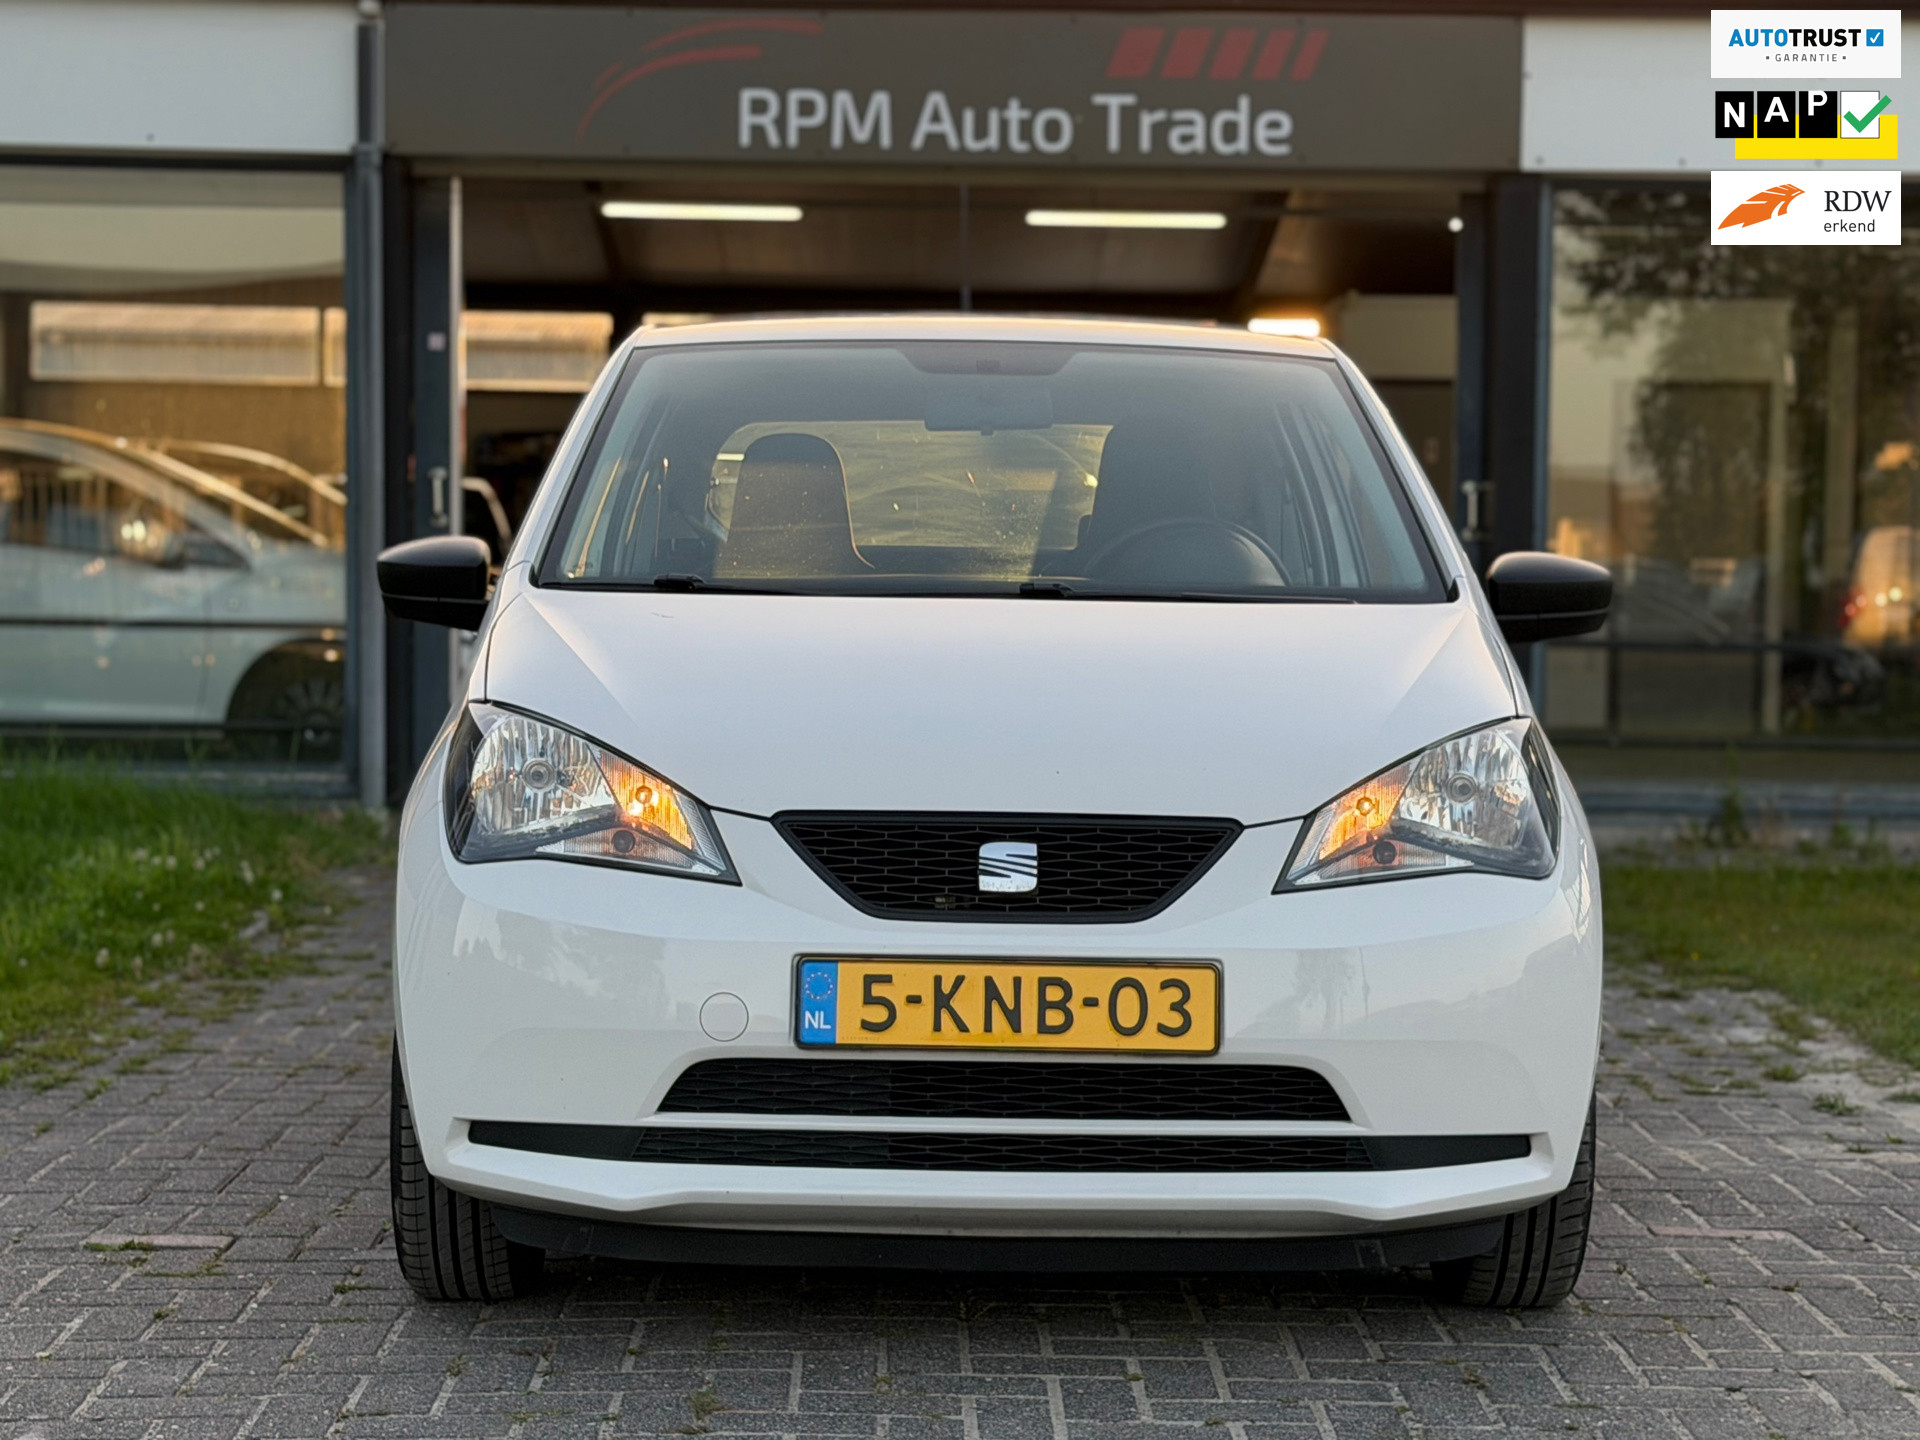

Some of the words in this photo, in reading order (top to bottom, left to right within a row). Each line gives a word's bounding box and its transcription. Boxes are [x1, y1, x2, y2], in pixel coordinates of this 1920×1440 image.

[738, 87, 892, 149] RPM
[911, 91, 1074, 153] Auto
[1091, 94, 1293, 155] Trade
[804, 1010, 832, 1030] NL
[860, 974, 1192, 1038] 5-KNB-03
